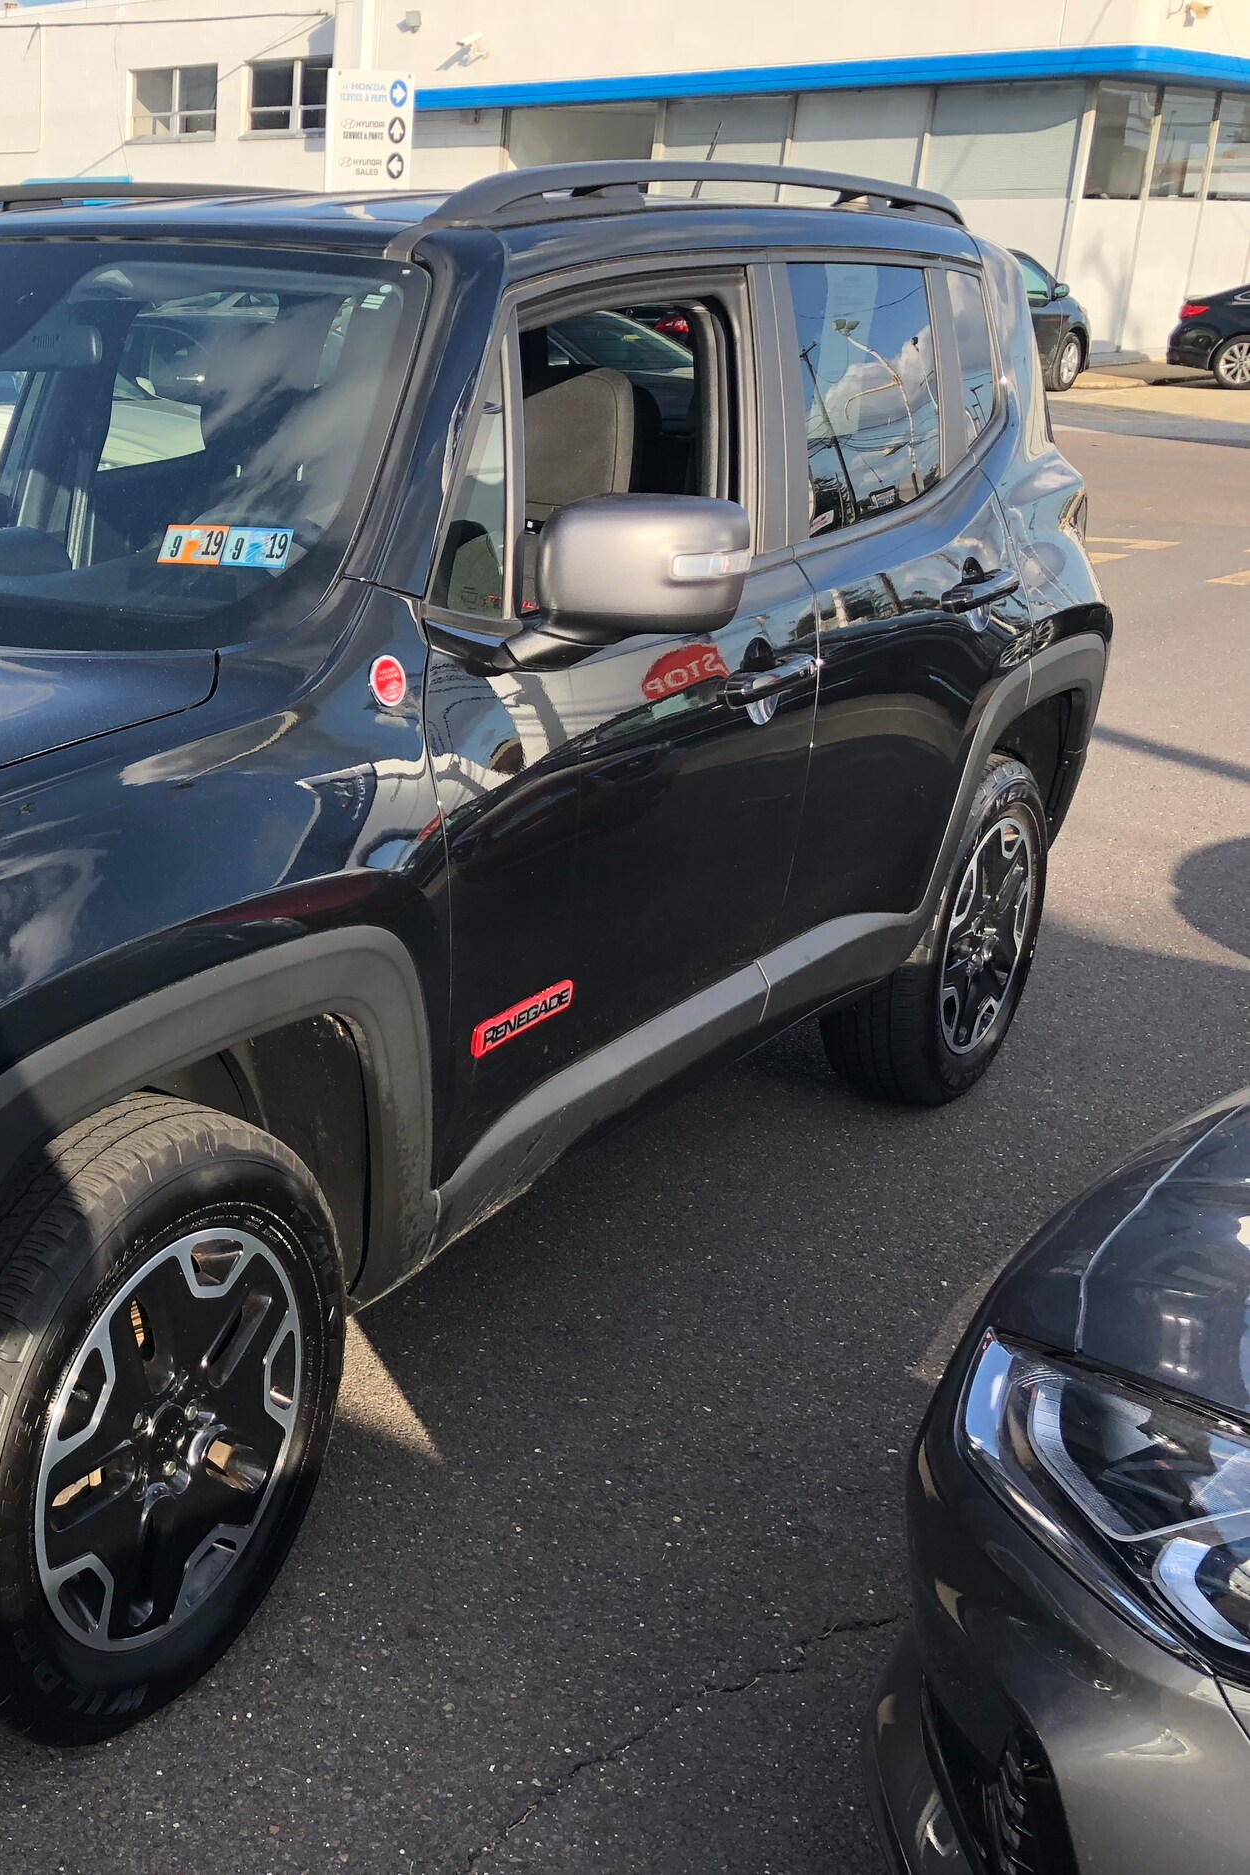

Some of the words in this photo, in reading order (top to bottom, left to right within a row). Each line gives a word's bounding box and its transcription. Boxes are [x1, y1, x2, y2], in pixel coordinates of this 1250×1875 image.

[351, 83, 386, 91] HONDA
[340, 93, 363, 102] SERVICE
[371, 94, 387, 102] PARTS
[355, 120, 385, 128] HYUNDAI
[343, 131, 363, 140] SERVICE
[368, 132, 383, 140] PARTS
[353, 158, 382, 166] HYUNDAI
[355, 168, 379, 176] SALES
[170, 535, 183, 558] 9
[201, 530, 225, 556] 19
[231, 537, 245, 561] 9
[265, 533, 288, 559] 19
[482, 988, 571, 1051] RENEGADE
